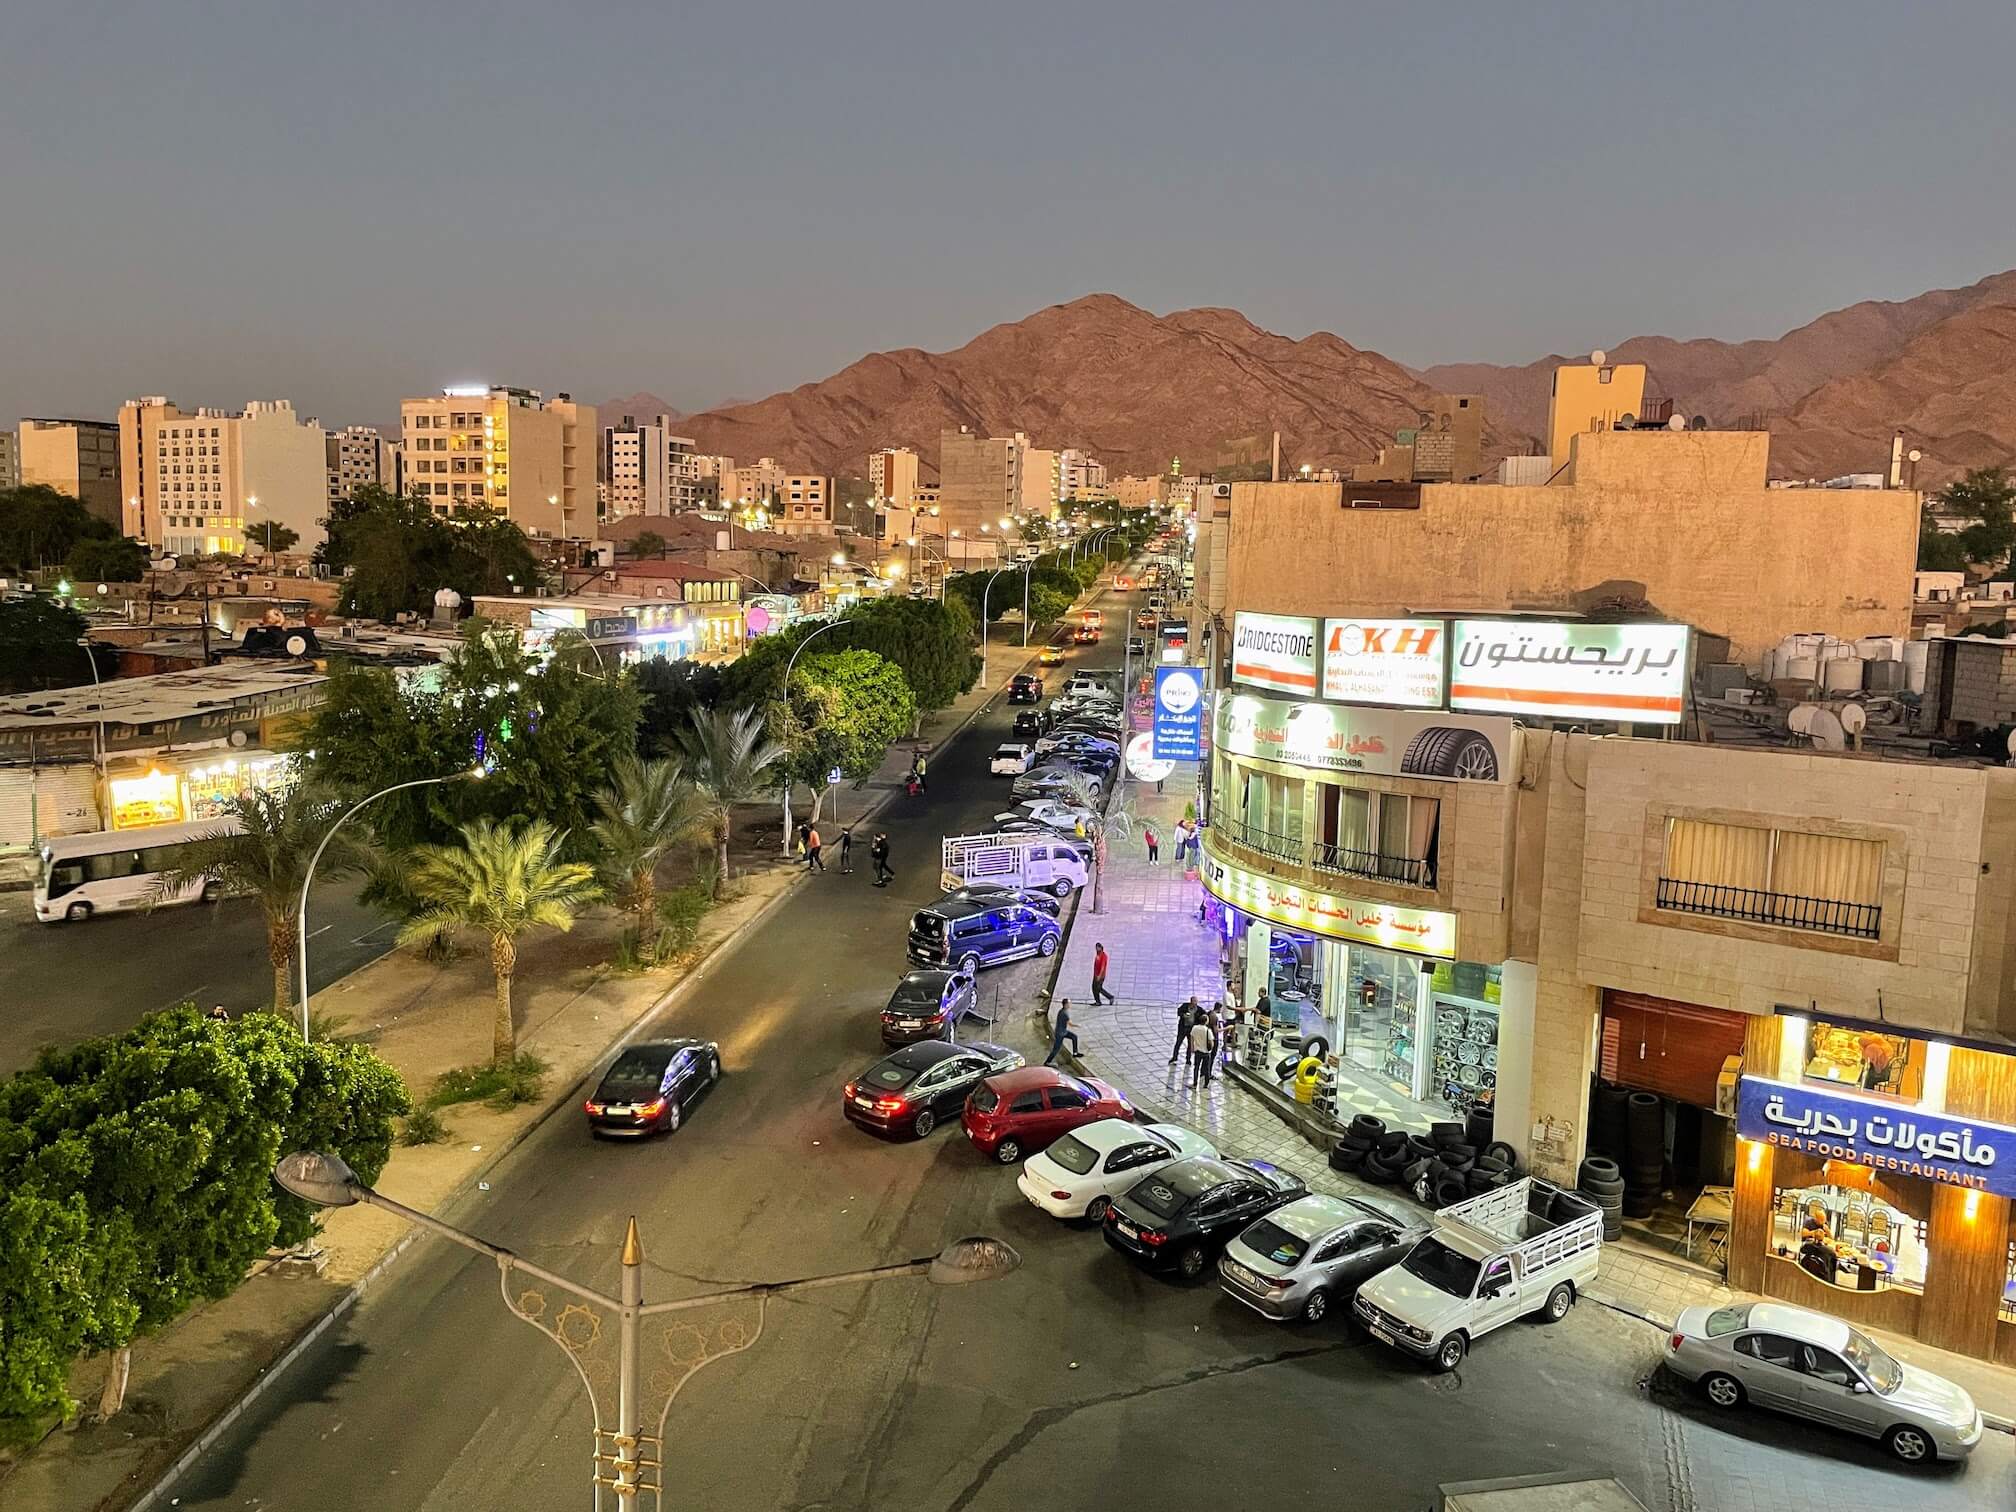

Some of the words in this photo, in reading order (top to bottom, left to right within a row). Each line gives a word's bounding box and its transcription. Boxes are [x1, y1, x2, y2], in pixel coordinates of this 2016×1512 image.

[1238, 625, 1314, 658] BRIDGESTONE
[1459, 634, 1678, 677] بريجستون
[1266, 886, 1305, 910] التجارية
[1307, 897, 1353, 921] الحسنات
[1356, 907, 1384, 929] خليل
[1390, 912, 1431, 937] مؤسسة
[1764, 1094, 1858, 1145] بحرية
[1865, 1115, 1997, 1167] مأكولات
[1768, 1131, 1802, 1150] SEA
[1807, 1139, 1857, 1162] FOOD
[1862, 1152, 1988, 1189] RESTAURANT
